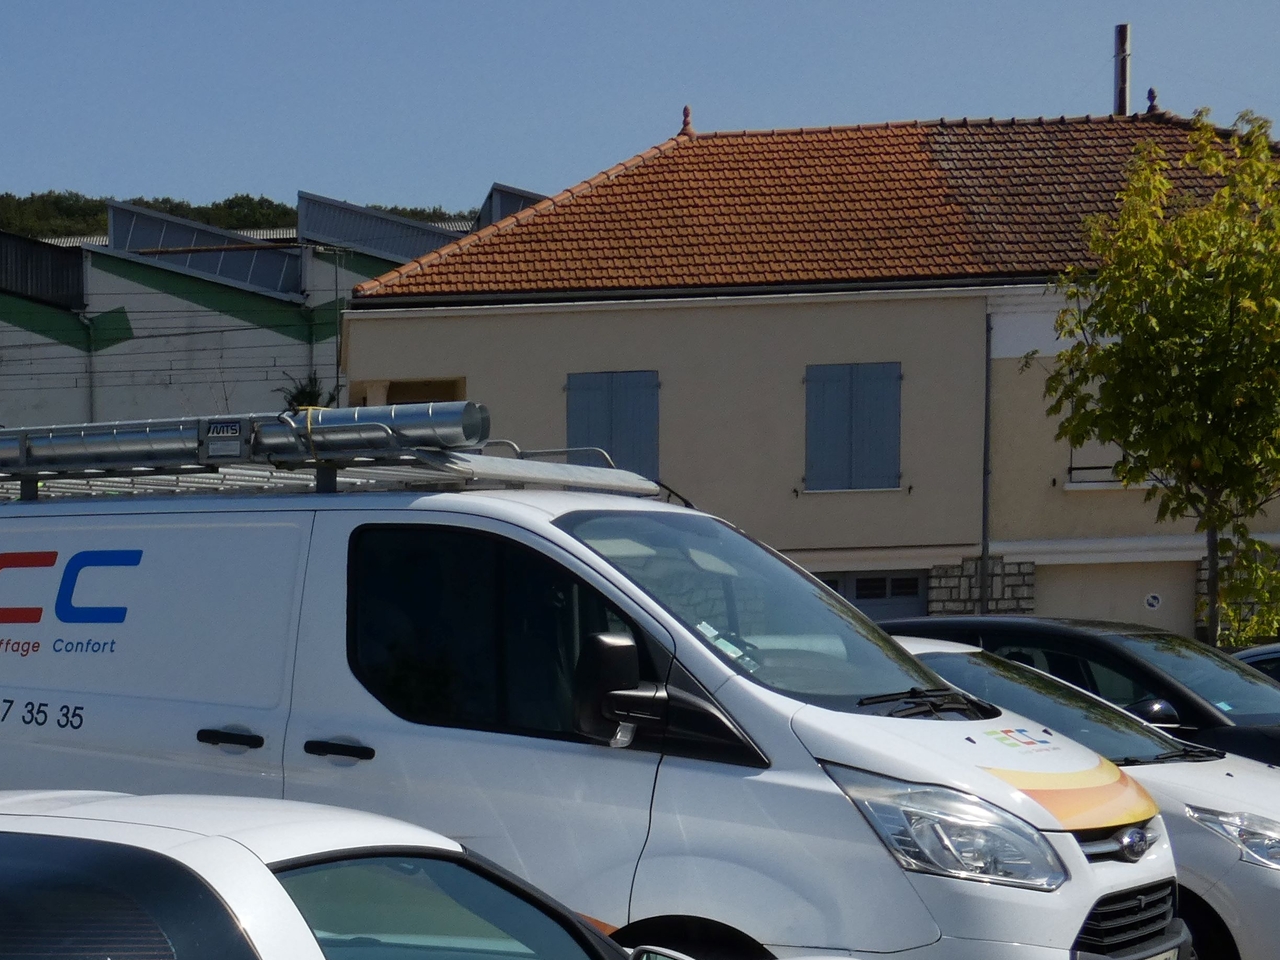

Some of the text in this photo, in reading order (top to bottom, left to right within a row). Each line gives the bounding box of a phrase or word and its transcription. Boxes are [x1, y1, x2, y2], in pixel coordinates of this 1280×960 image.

[52, 638, 116, 653] Confort
[21, 701, 49, 726] 35
[56, 704, 84, 729] 35
